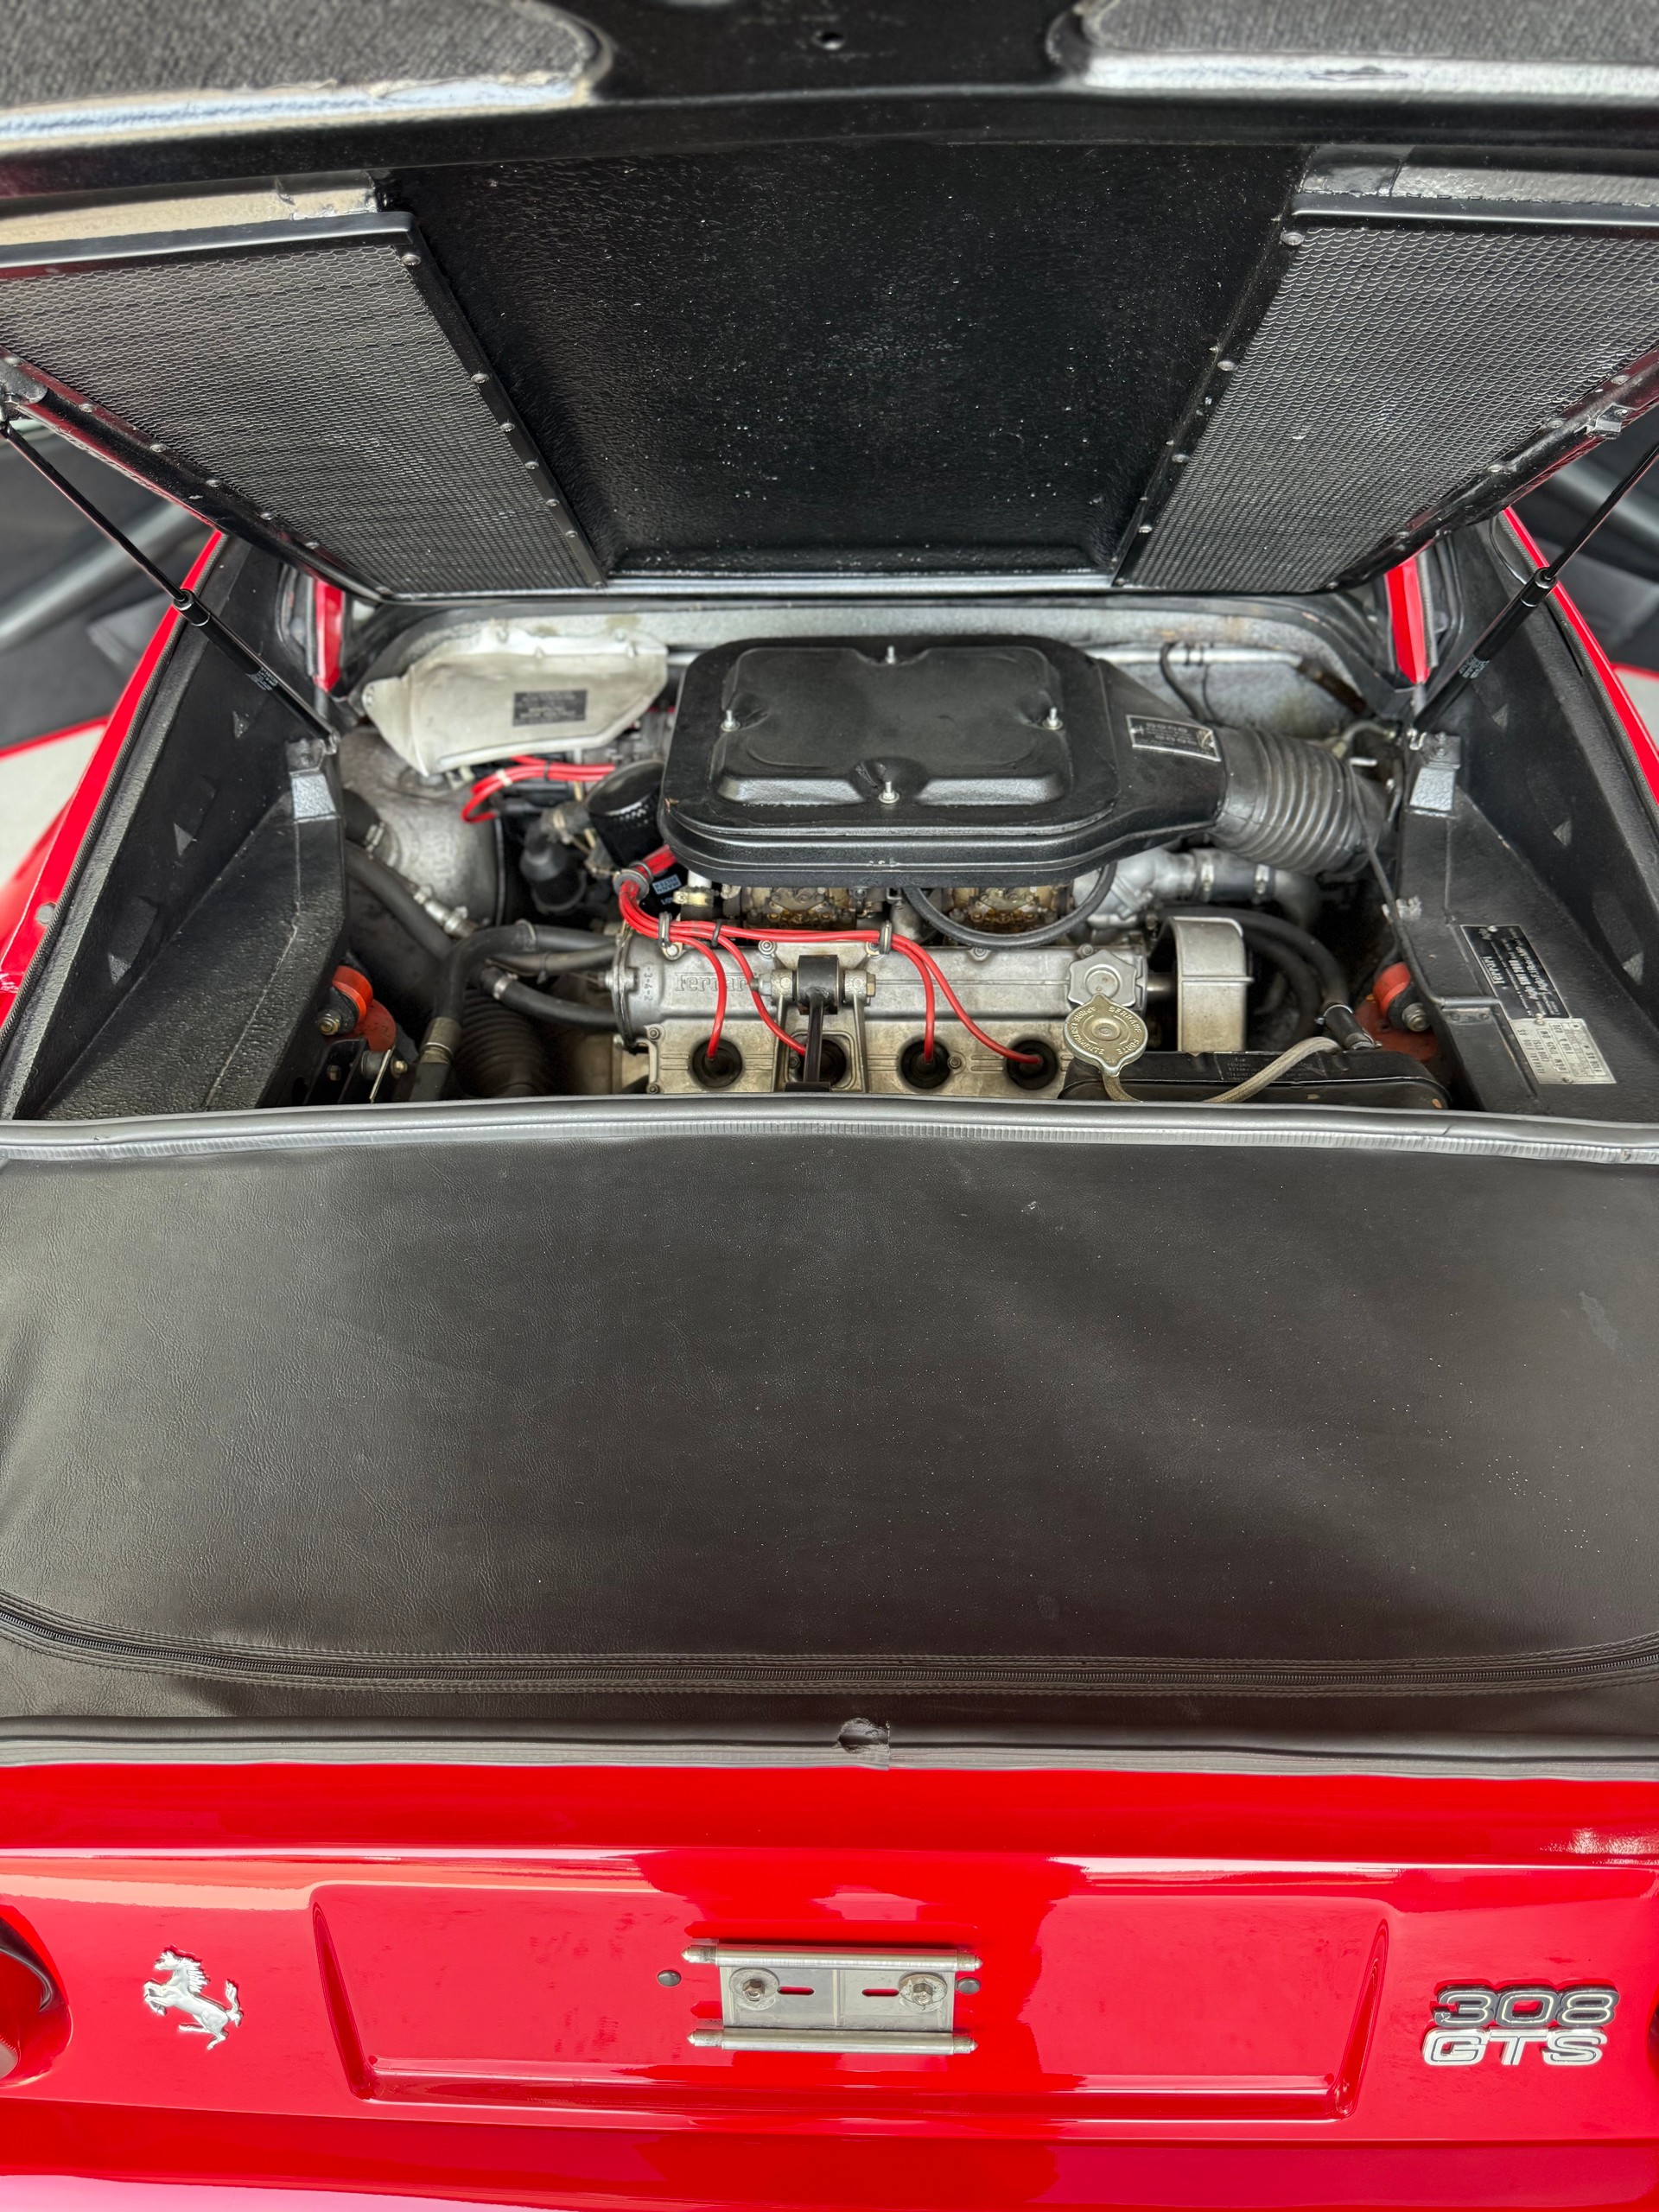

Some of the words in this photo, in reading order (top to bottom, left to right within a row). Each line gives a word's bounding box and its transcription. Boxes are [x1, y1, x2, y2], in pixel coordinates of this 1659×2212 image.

[675, 971, 757, 992] Ferar
[1109, 1006, 1142, 1033] SERRARE
[1116, 1039, 1140, 1055] FORTE
[1432, 1985, 1621, 2028] 308
[1421, 2026, 1609, 2066] GTS
